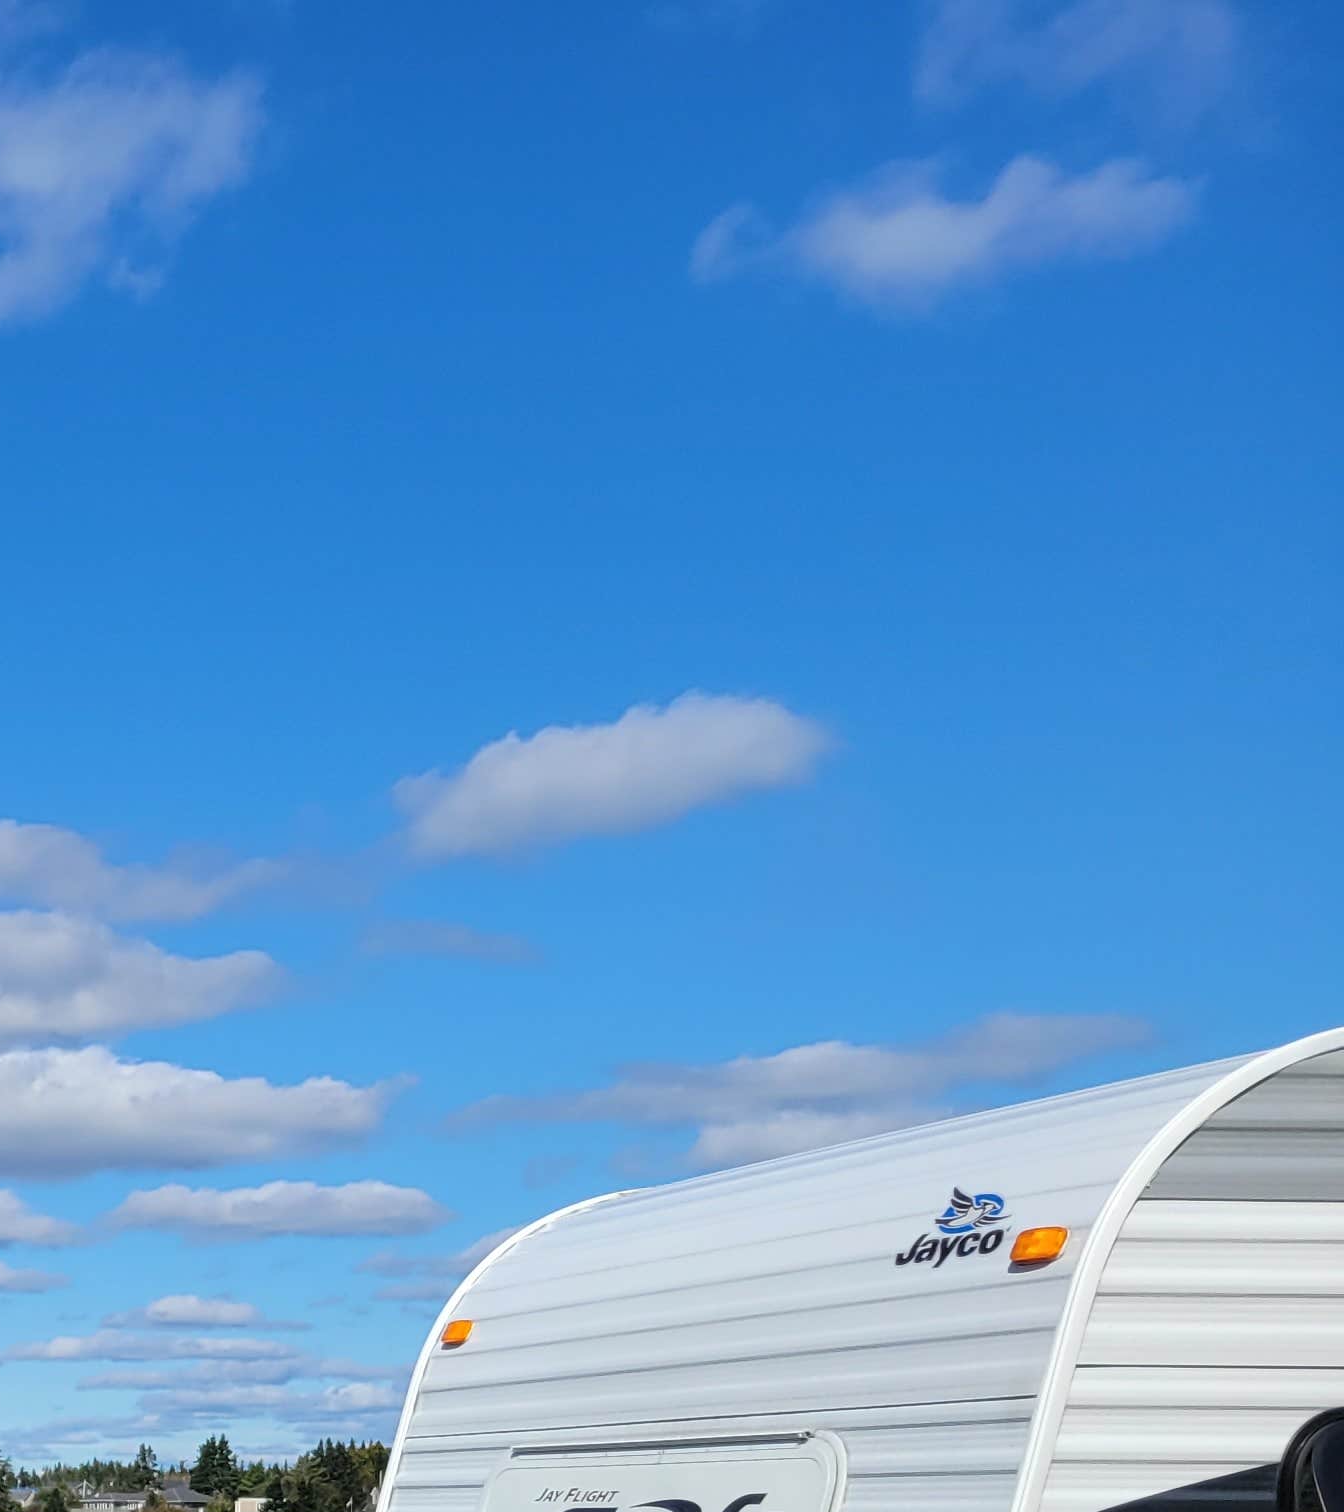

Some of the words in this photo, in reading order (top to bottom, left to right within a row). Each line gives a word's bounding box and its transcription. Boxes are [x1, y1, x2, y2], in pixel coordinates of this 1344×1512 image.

[895, 1228, 1004, 1268] Jayco
[535, 1487, 564, 1502] JAY
[563, 1487, 620, 1503] FLIGHT
